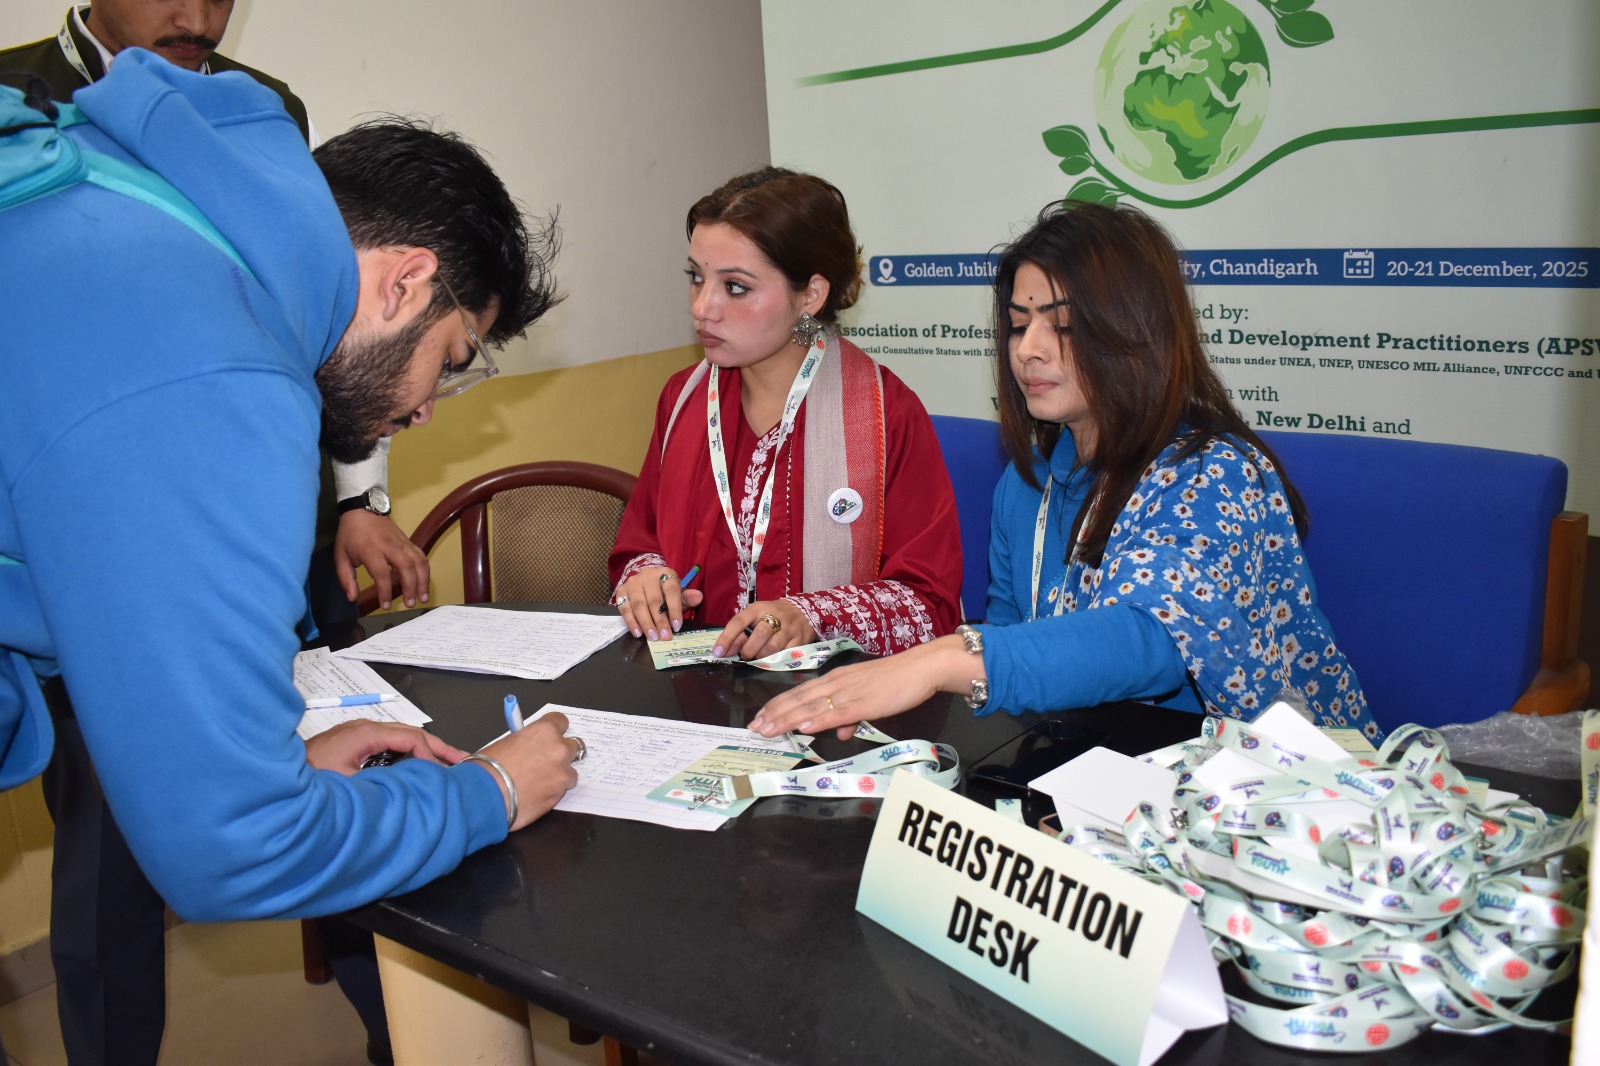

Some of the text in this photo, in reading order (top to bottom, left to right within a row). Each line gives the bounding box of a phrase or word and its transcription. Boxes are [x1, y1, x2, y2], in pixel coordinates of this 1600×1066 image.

[904, 258, 1319, 279] Golden Jubile ity, Chandigarh
[1386, 260, 1589, 279] 20-21 December, 2025
[1193, 303, 1249, 324] ed by:
[841, 323, 919, 338] ssociation
[922, 324, 938, 338] of
[940, 324, 999, 339] Profess
[1200, 328, 1223, 344] nd
[1228, 329, 1371, 351] Development
[1376, 332, 1530, 354] Practitioners
[861, 345, 881, 354] ecial
[882, 345, 934, 355] Consultative
[935, 347, 961, 356] Status
[963, 348, 982, 357] with
[984, 349, 998, 357] EC
[1209, 354, 1242, 365] Status
[1244, 356, 1277, 366] under
[1279, 356, 1316, 369] UNEA,
[1319, 358, 1354, 371] UNEP,
[1357, 359, 1410, 371] UNESCO
[1413, 361, 1440, 372] MIL
[1442, 362, 1500, 376] Alliance,
[1504, 365, 1564, 377] UNFCCC
[1567, 368, 1593, 379] and
[1238, 386, 1280, 402] with
[1256, 410, 1302, 428] New
[1306, 413, 1367, 432] Delhi
[1372, 419, 1412, 435] and
[897, 799, 1144, 960] REGISTRATION
[945, 895, 1040, 984] DESK
